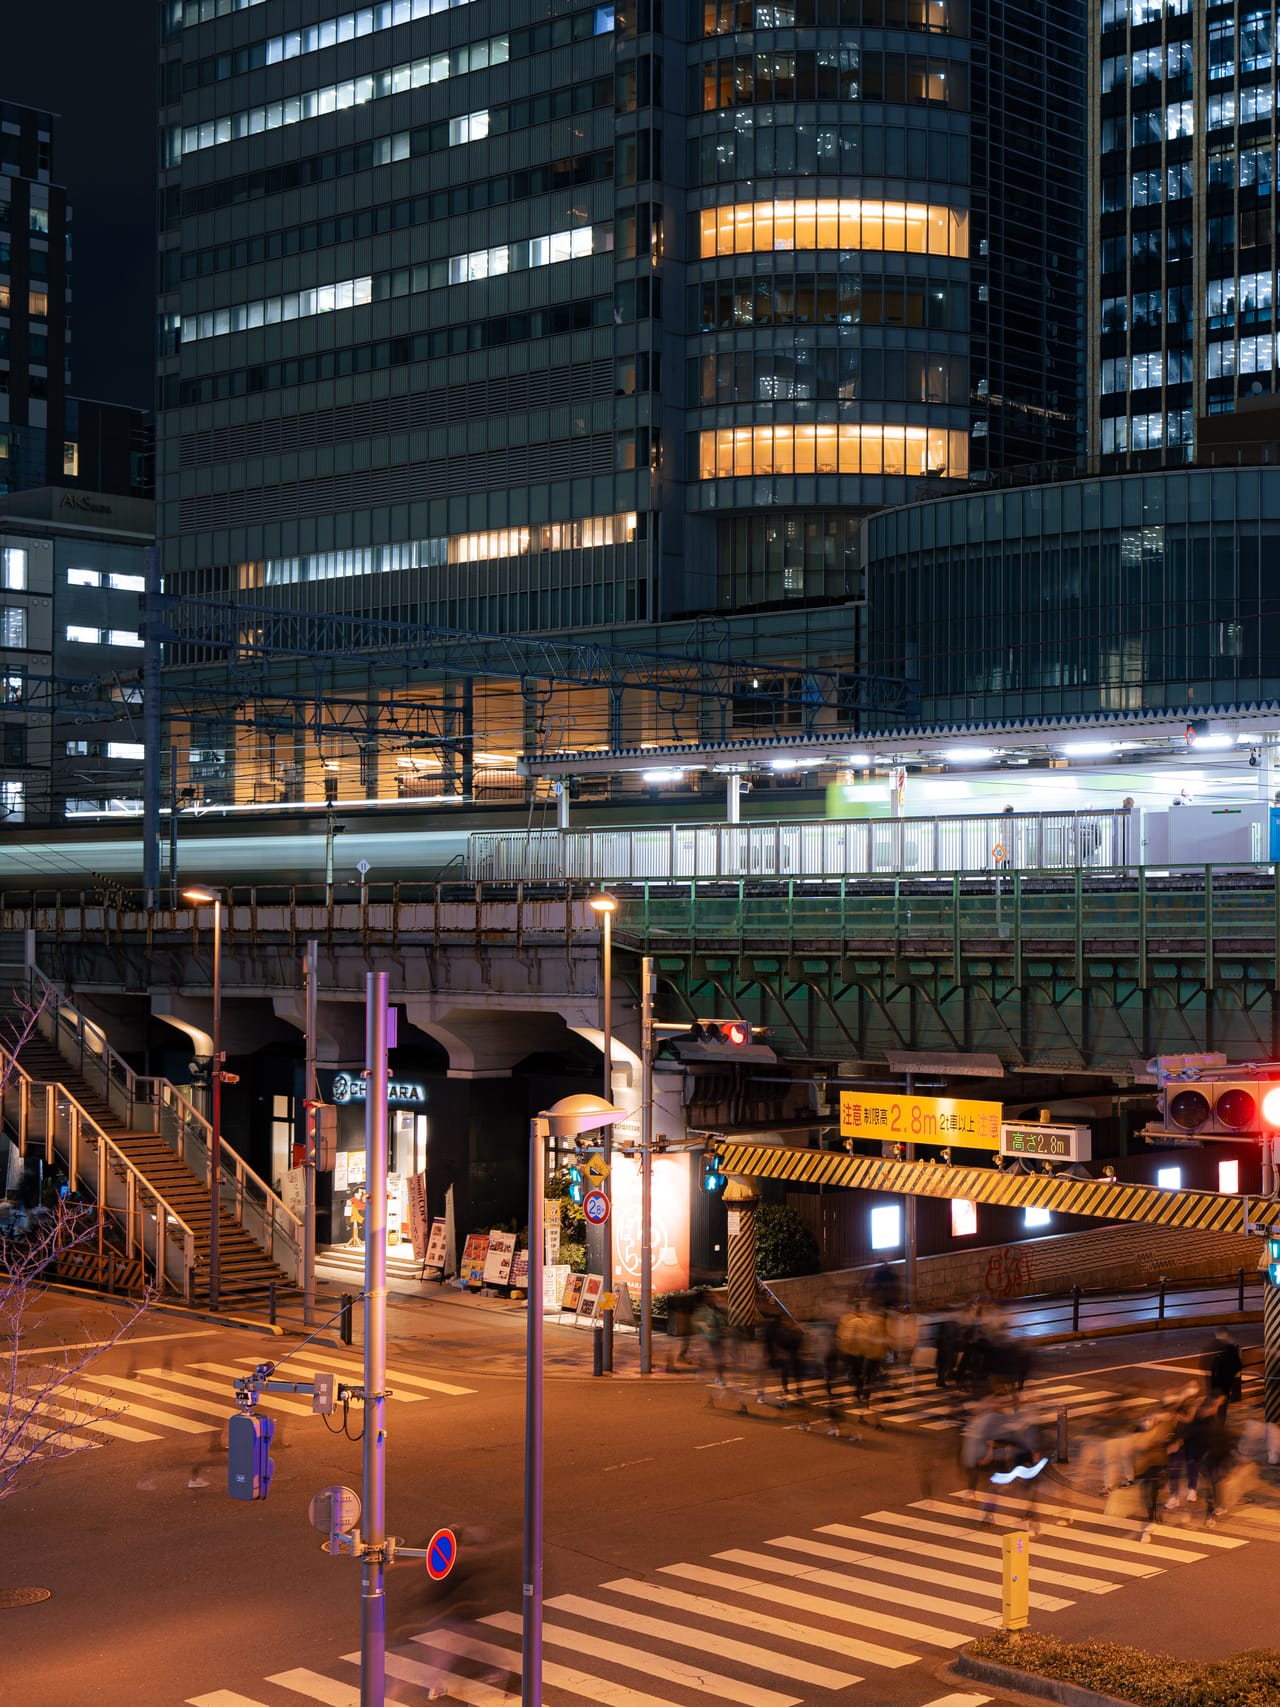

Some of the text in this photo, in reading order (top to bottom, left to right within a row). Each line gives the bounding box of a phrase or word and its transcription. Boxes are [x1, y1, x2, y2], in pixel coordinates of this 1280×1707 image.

[842, 1103, 999, 1139] 注意 制限高 2.8m 2t車以上 注意
[1011, 1132, 1065, 1154] 高さ2.8m
